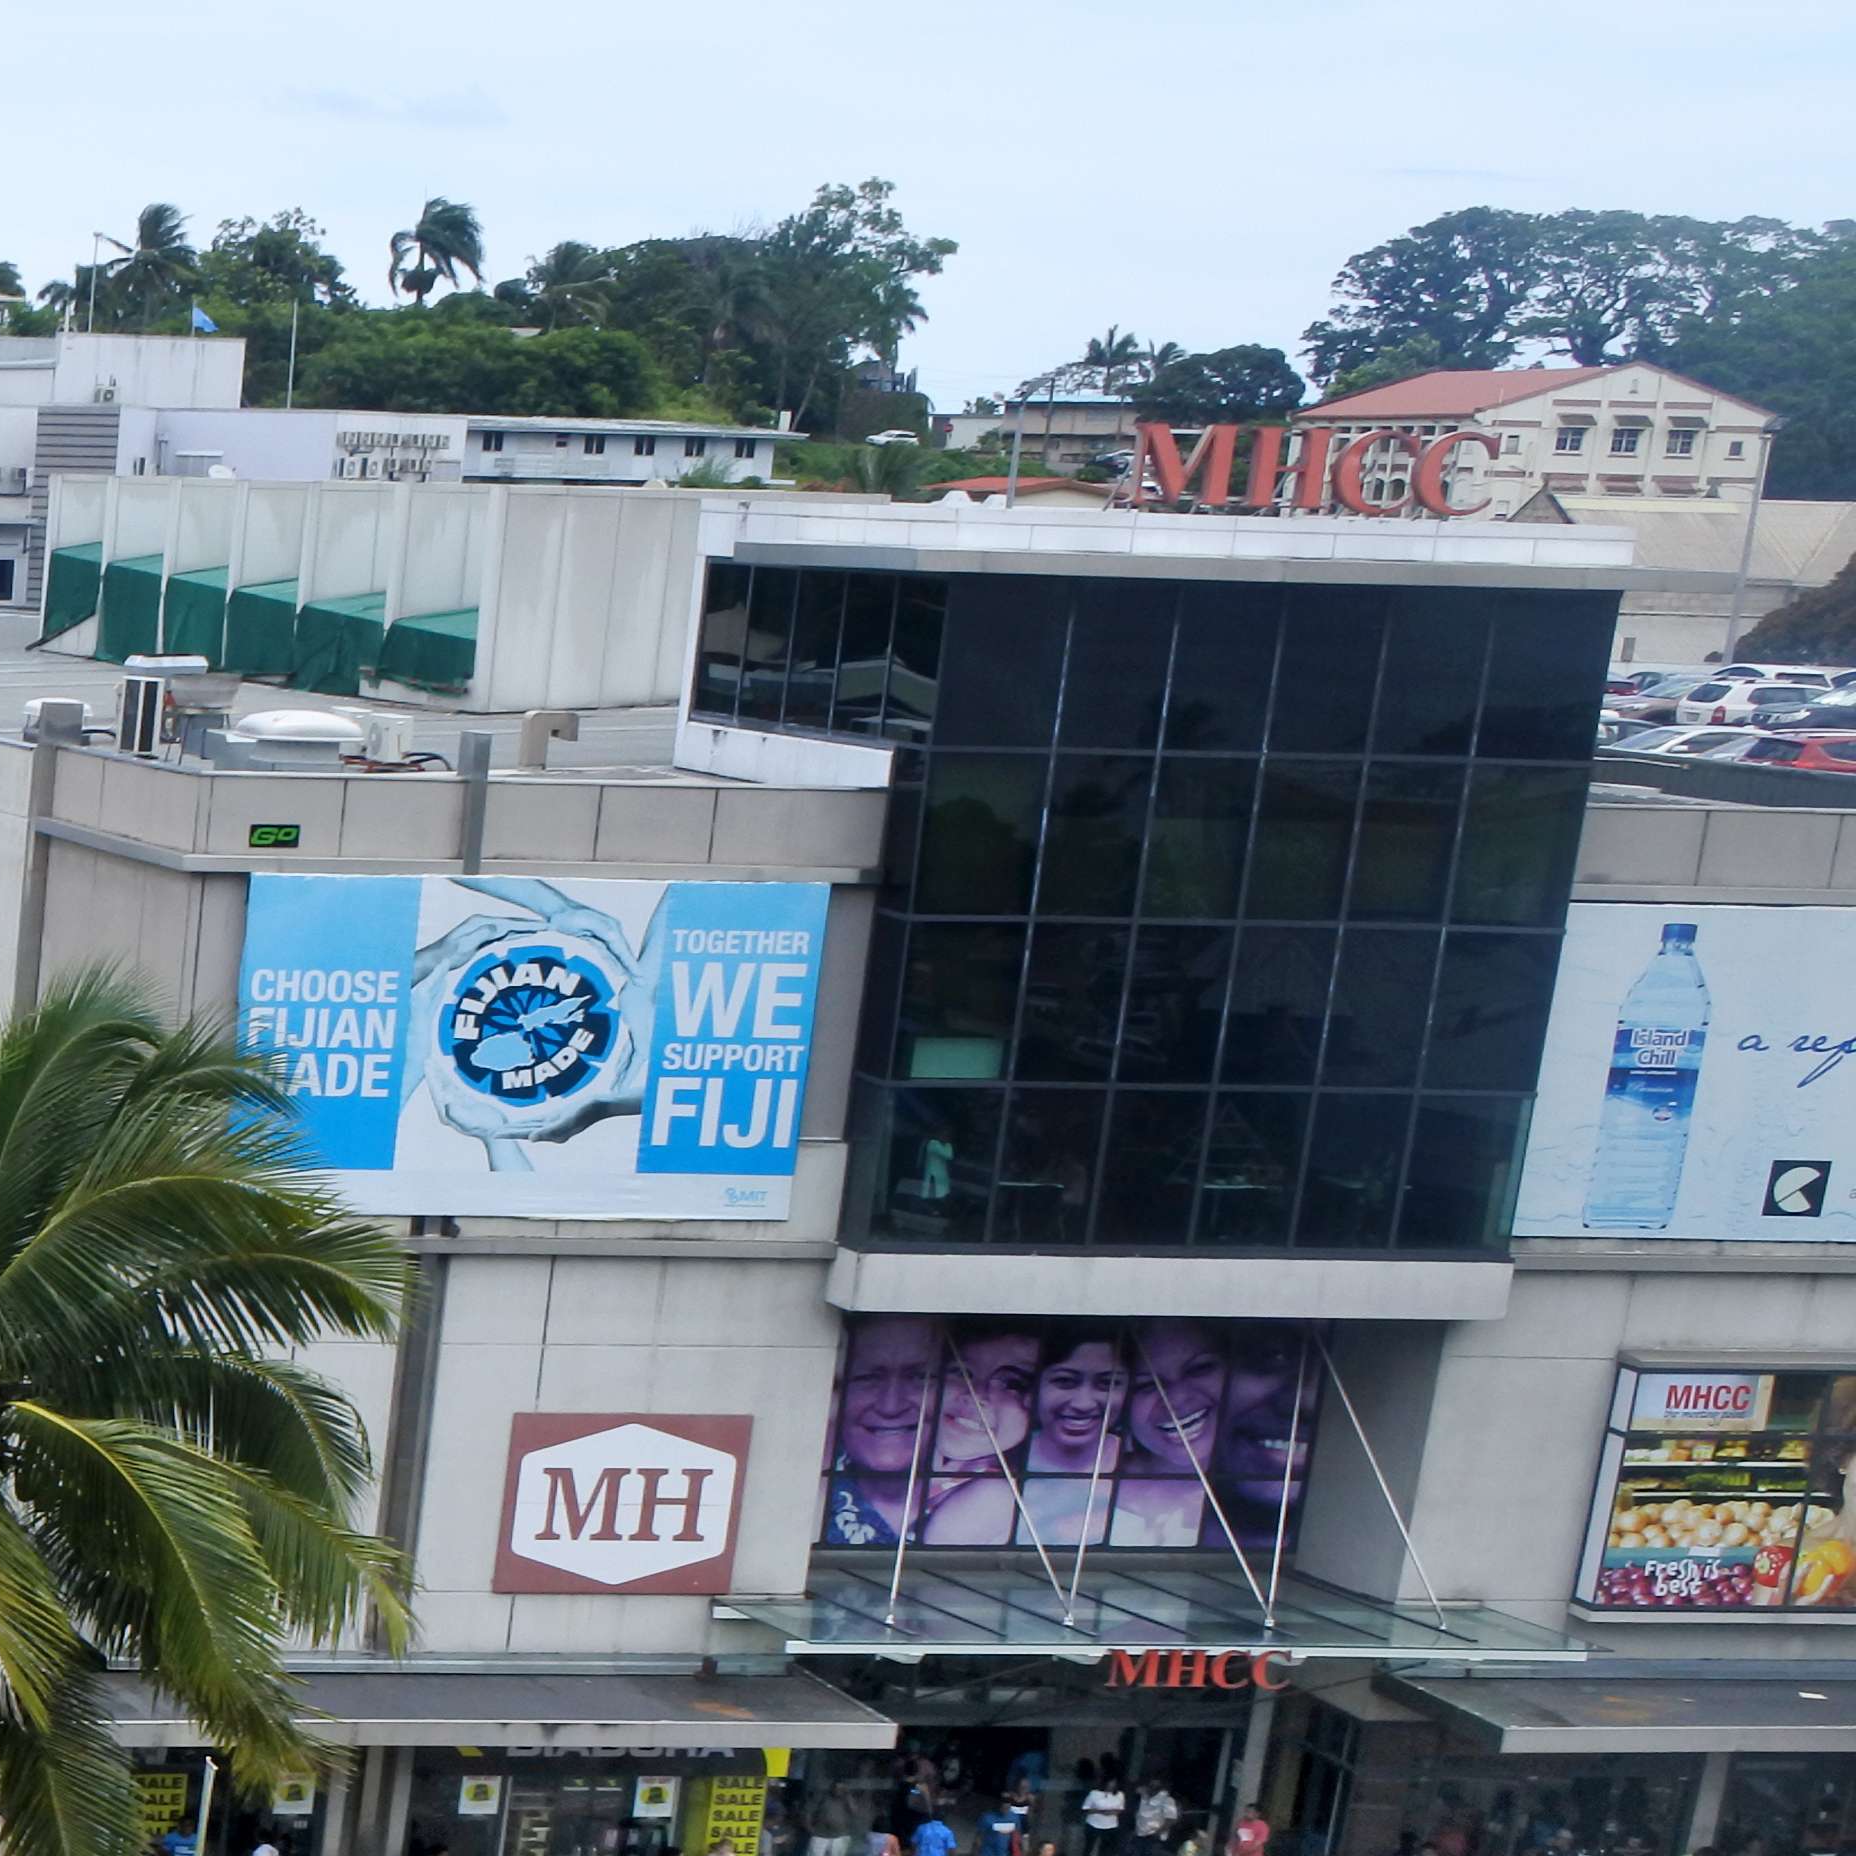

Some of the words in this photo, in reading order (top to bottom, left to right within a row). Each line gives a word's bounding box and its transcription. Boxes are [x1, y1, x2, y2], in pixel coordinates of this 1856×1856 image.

[1133, 421, 1502, 518] MHCC
[672, 929, 811, 956] TOGETHER
[250, 968, 400, 1004] CHOOSE
[454, 961, 581, 1041] FIJIAN
[668, 962, 807, 1040] WE
[246, 1007, 398, 1049] FIJIAN
[1633, 1029, 1688, 1047] Island
[1737, 1034, 1770, 1051] a
[501, 1025, 596, 1091] MADE
[662, 1043, 805, 1073] SUPPORT
[1638, 1050, 1676, 1066] Chill
[650, 1077, 799, 1149] FIJI
[1665, 1384, 1752, 1411] MHCC
[537, 1466, 715, 1545] MH
[1644, 1559, 1698, 1579] Fresh
[1703, 1558, 1721, 1579] is
[1654, 1577, 1703, 1598] best
[1106, 1648, 1294, 1692] MHCC
[717, 1776, 764, 1789] SALE
[714, 1793, 762, 1805] SALE
[712, 1809, 760, 1822] SALE
[710, 1826, 758, 1838] SALE
